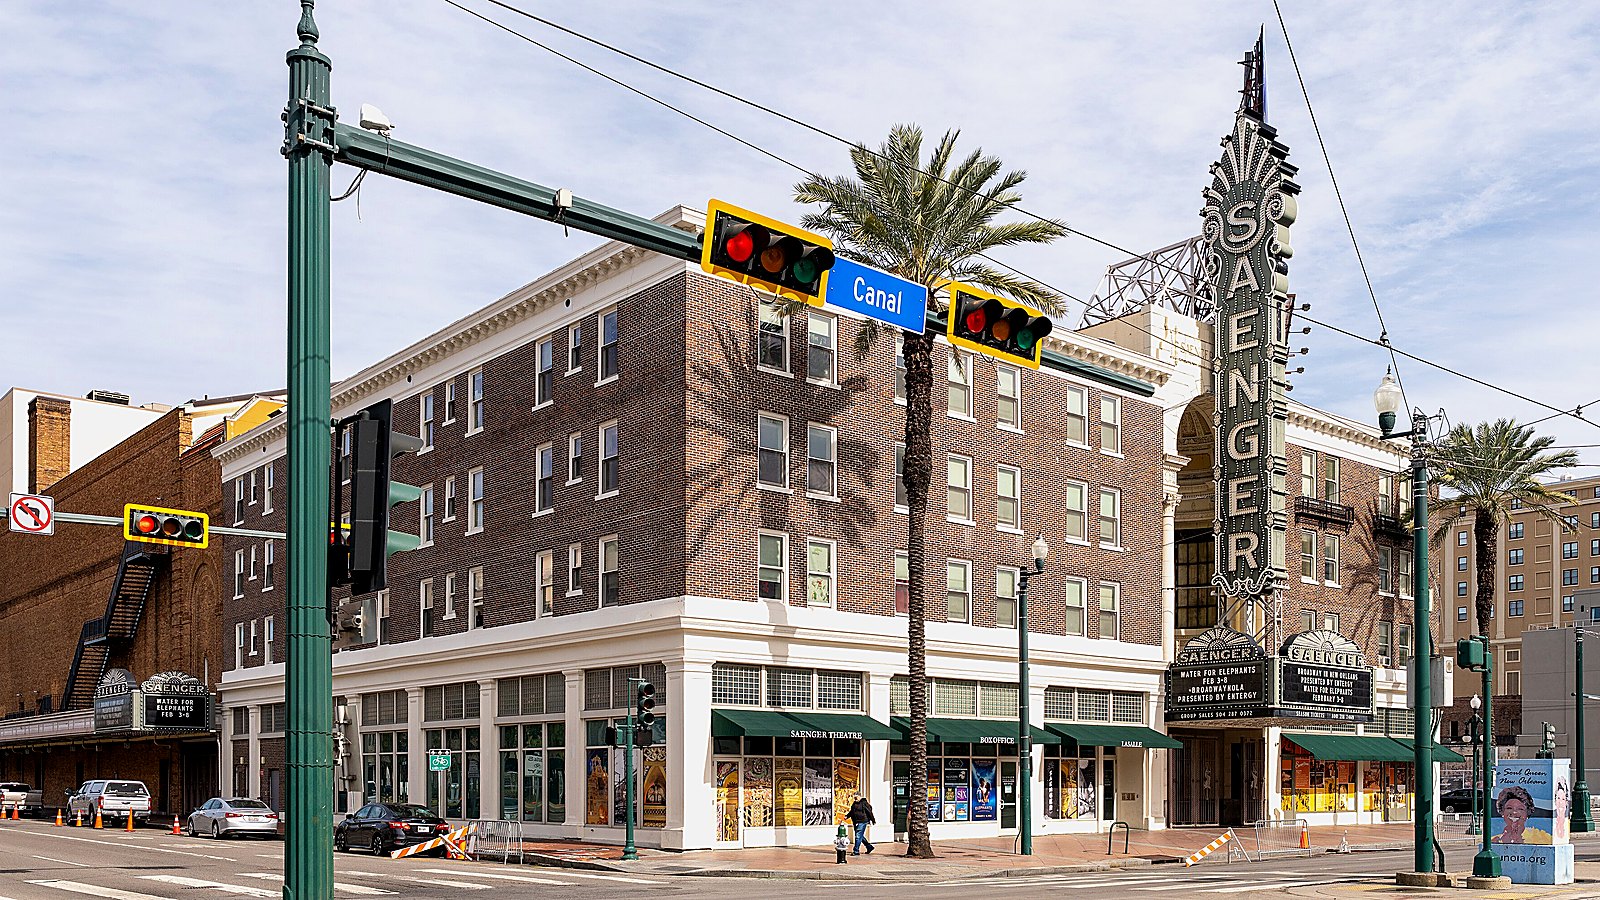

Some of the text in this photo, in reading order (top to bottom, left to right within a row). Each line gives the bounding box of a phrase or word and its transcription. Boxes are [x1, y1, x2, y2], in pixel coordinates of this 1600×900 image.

[852, 275, 903, 315] Canal
[1226, 200, 1260, 573] SAENGER
[1180, 648, 1251, 662] SAENGER
[1292, 648, 1365, 667] SAENGER
[1180, 666, 1256, 678] WATER FOR ELEPHANTS
[1297, 668, 1322, 677] BROADWAY
[1339, 672, 1358, 680] ORLEANS
[146, 683, 205, 693] SAENGER
[1300, 676, 1325, 685] PRESENTED
[1334, 679, 1353, 688] ENTERGY
[98, 684, 126, 696] SAENGER
[1303, 685, 1318, 693] WATER
[1330, 687, 1353, 696] ELEPHANTS
[1177, 694, 1214, 702] PRESENTED
[1227, 692, 1257, 700] ENTERGY
[1312, 694, 1335, 702] FEBRUARY
[790, 729, 863, 740] SAENGER THEATRE
[1504, 768, 1523, 776] Soul
[1524, 768, 1547, 777] Queen
[1518, 776, 1547, 785] Orleans
